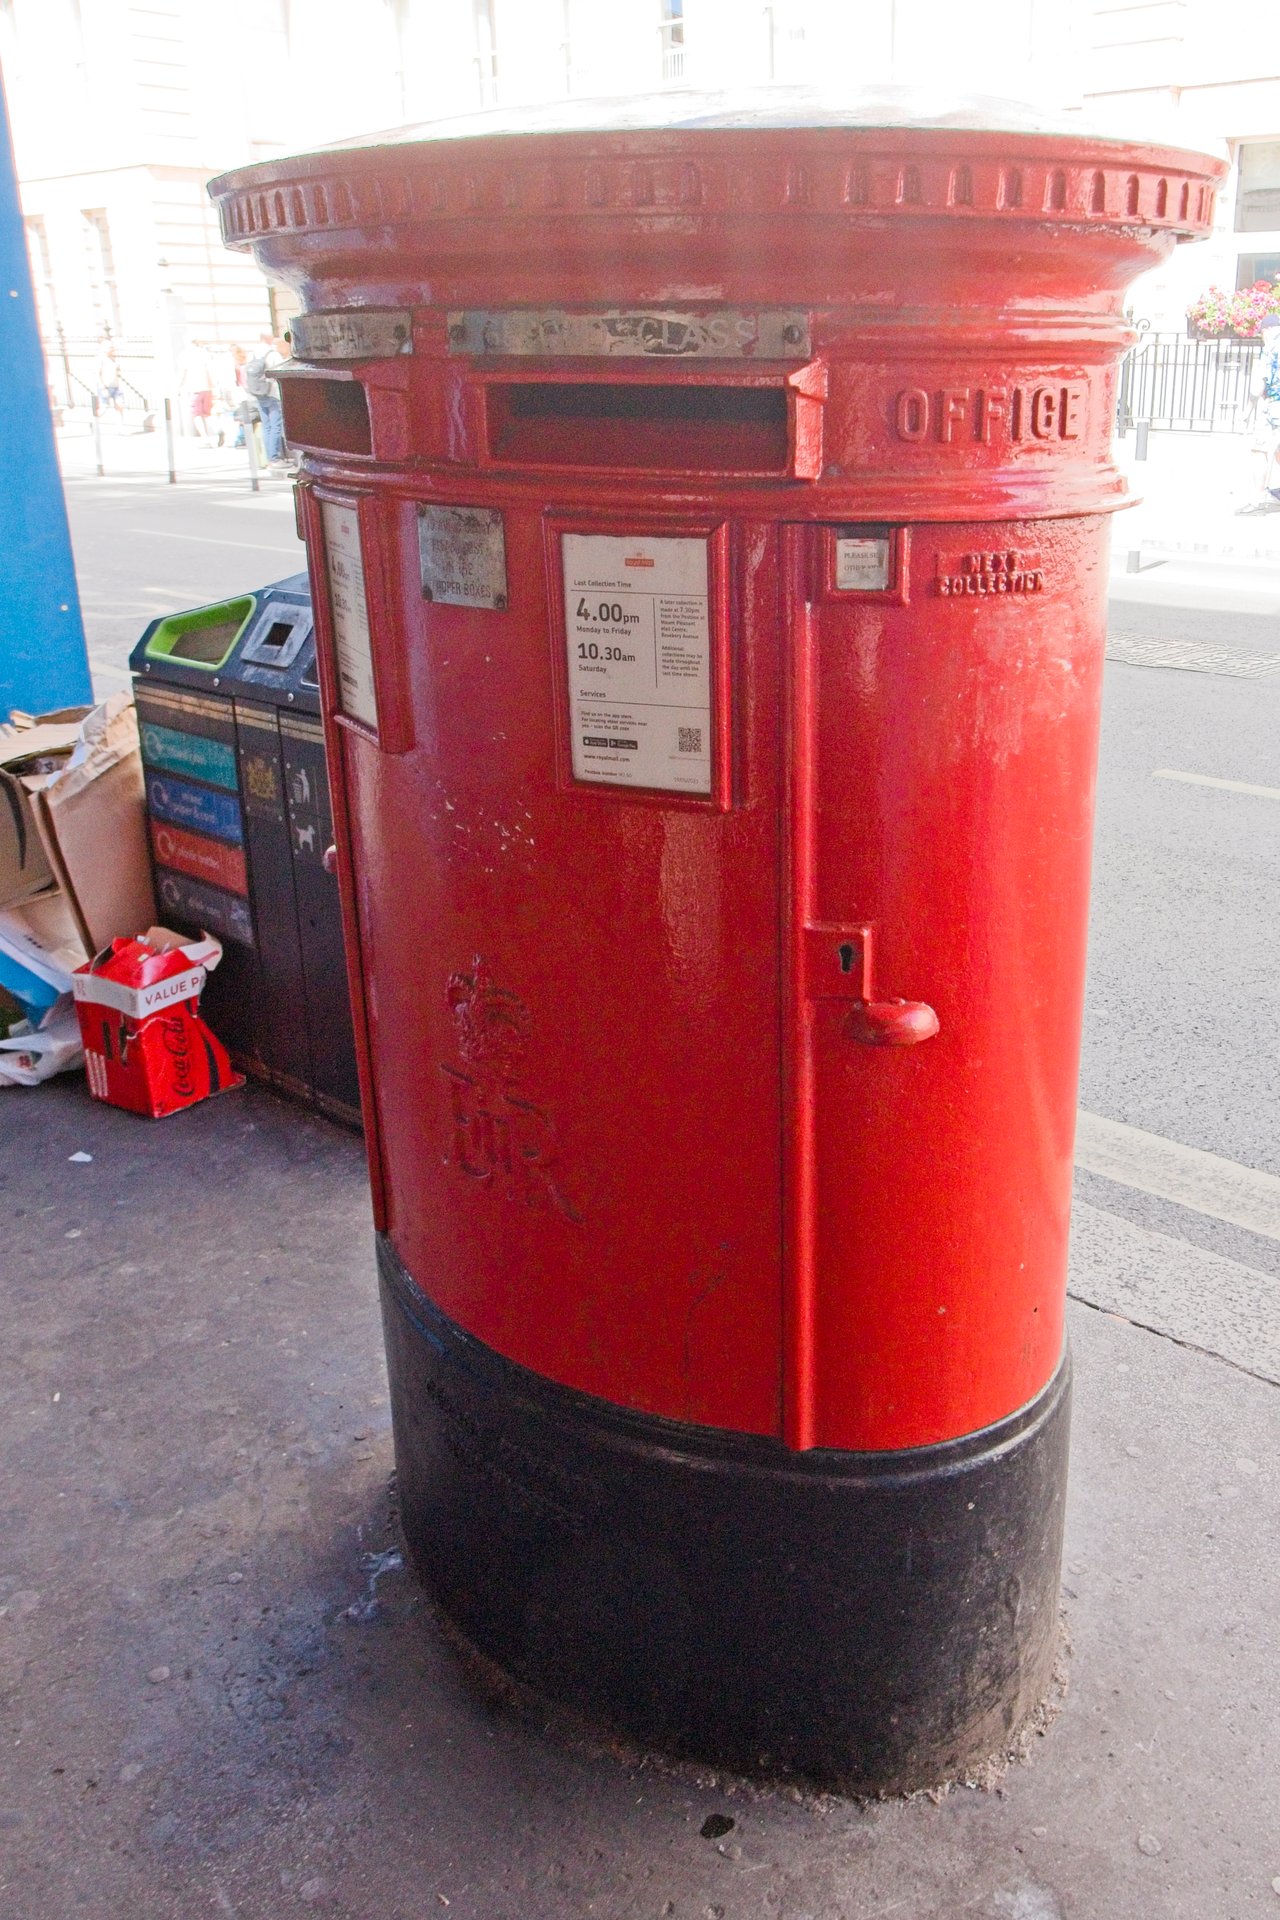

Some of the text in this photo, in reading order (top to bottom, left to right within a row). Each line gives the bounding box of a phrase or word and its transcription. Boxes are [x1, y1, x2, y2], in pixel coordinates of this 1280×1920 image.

[639, 316, 755, 350] CLASS
[898, 386, 1083, 442] OFFICE
[966, 551, 1024, 574] NEXT
[463, 582, 491, 598] BOXES
[936, 571, 1043, 596] COLLECTION
[576, 597, 640, 625] 4.00pm
[576, 626, 632, 636] Monday to Friday
[577, 643, 636, 662] 10.30am
[578, 664, 607, 674] Saturday
[579, 689, 607, 698] Services
[145, 980, 187, 1005] VALUE
